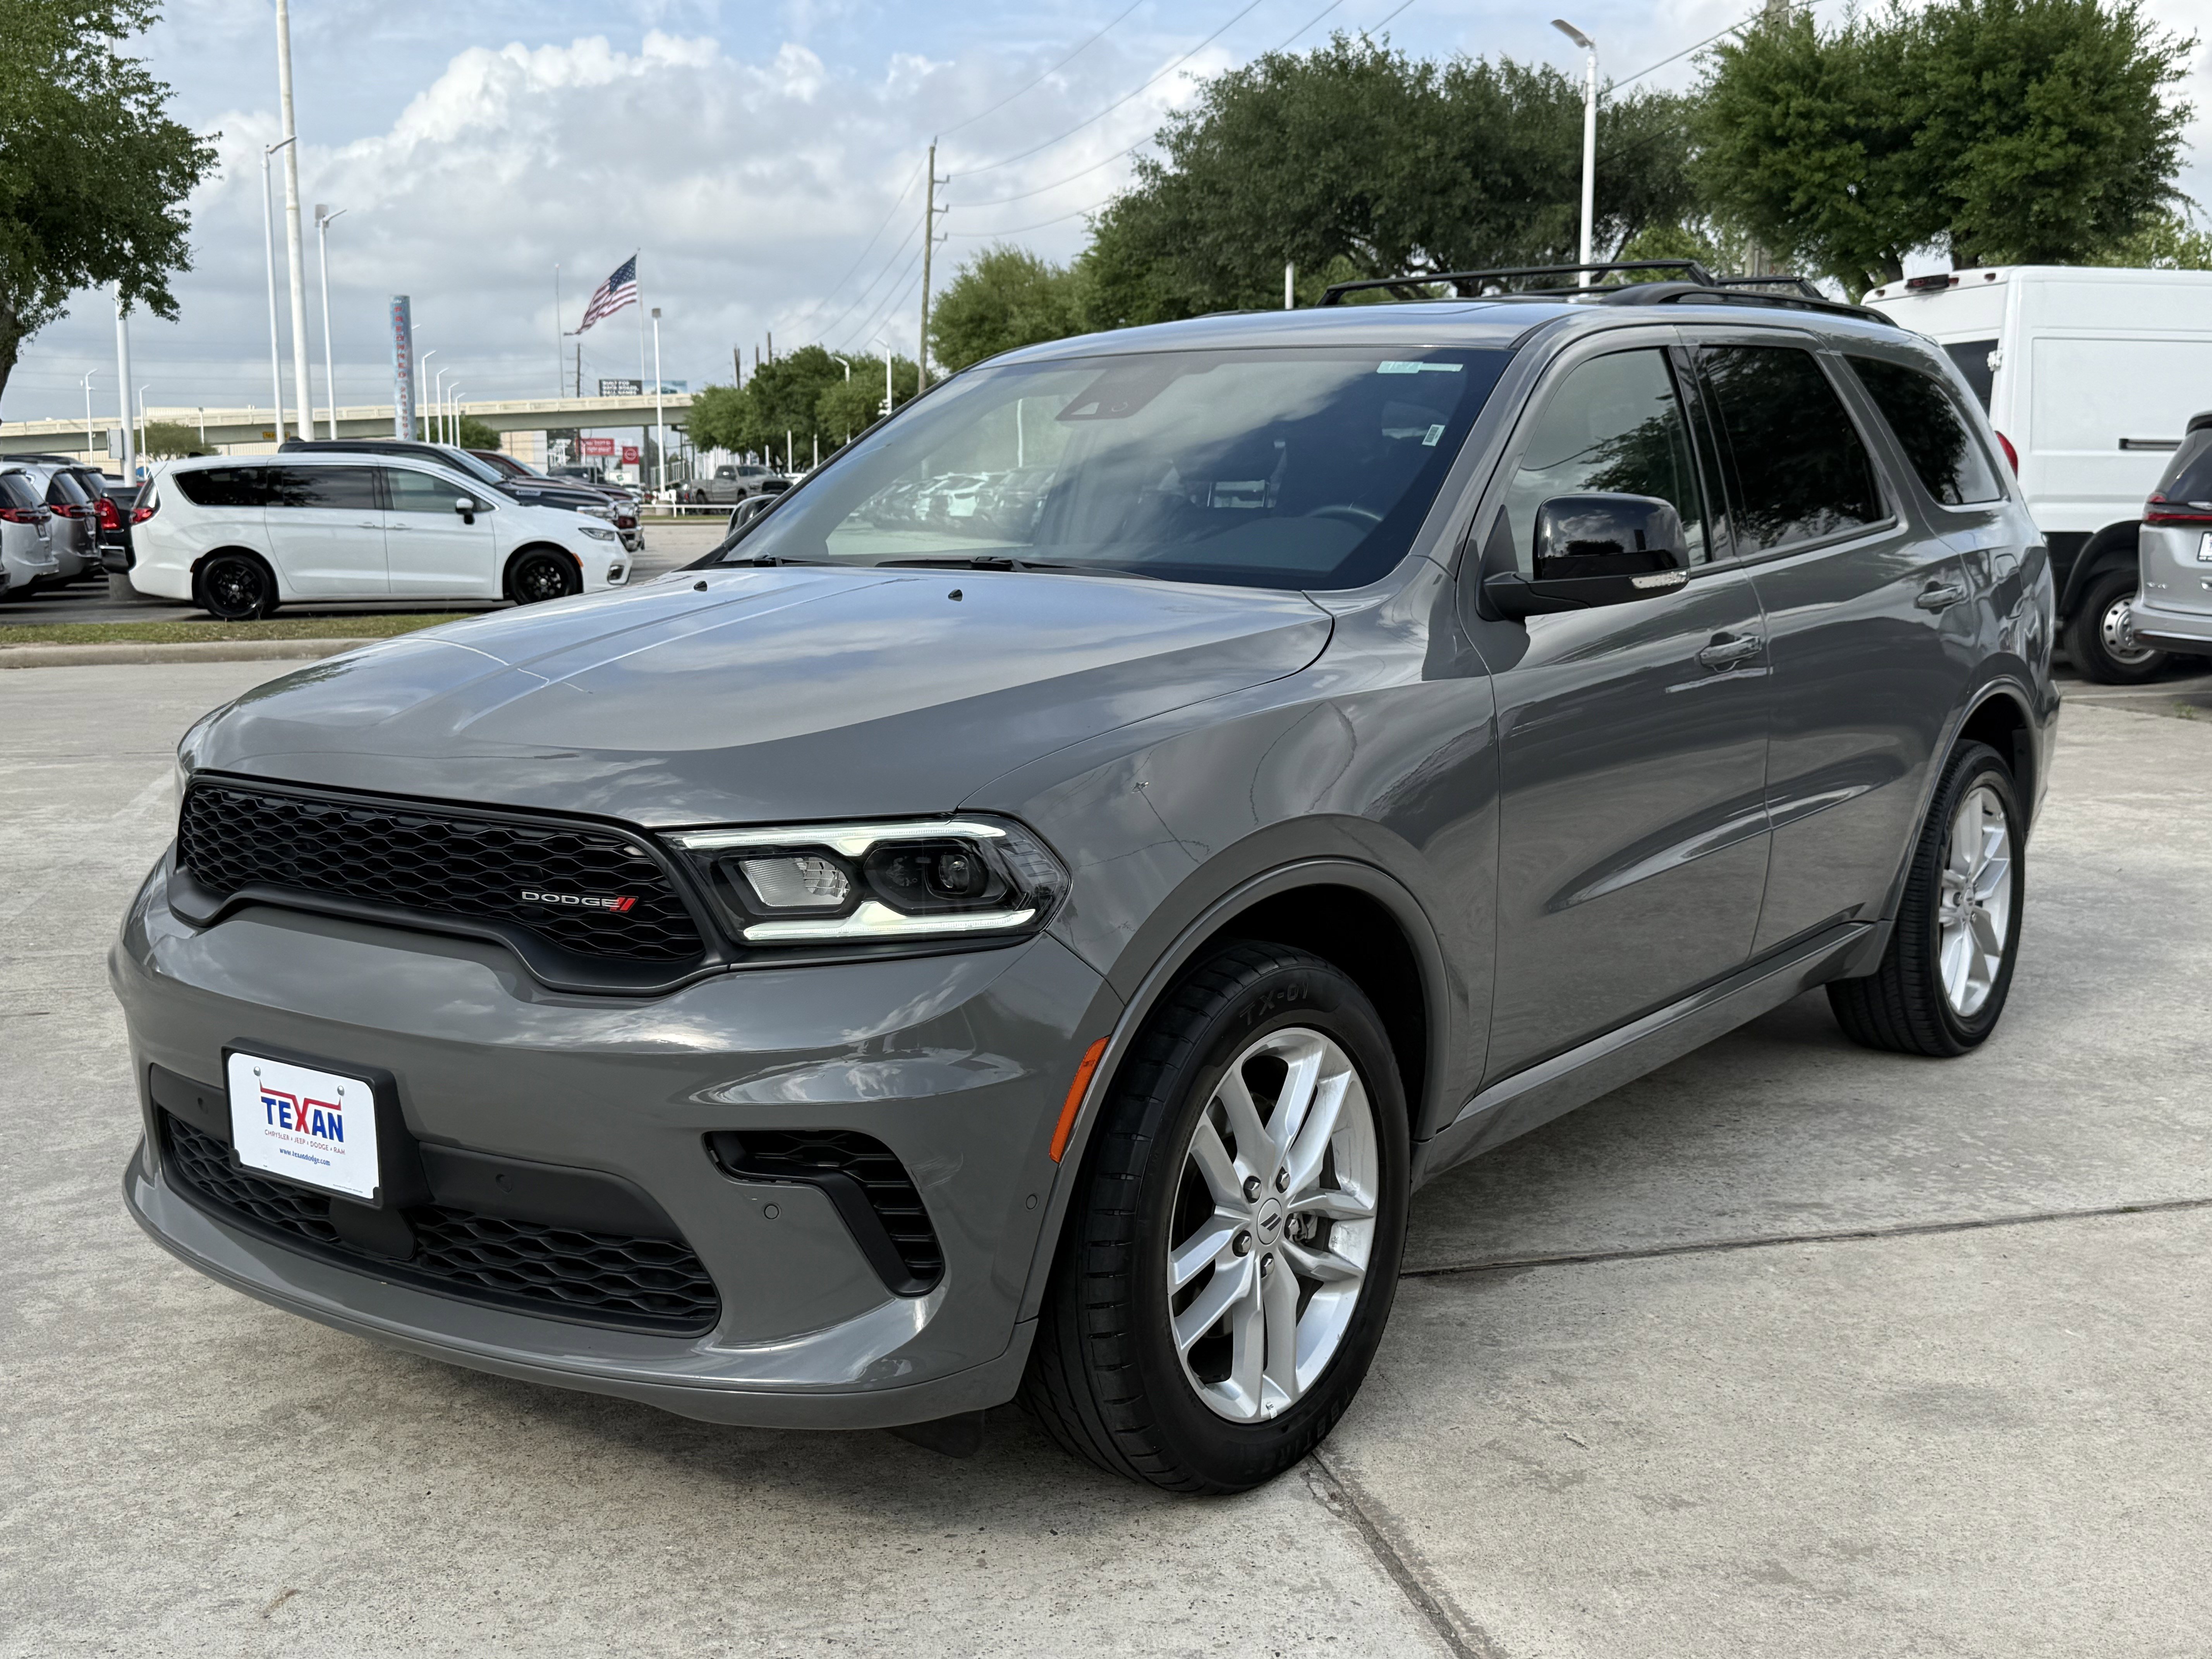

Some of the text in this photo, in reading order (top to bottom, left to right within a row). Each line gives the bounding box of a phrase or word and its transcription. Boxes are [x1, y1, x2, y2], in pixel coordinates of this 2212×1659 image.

[522, 891, 620, 908] DODGE
[1239, 979, 1309, 1025] TX-01
[261, 1094, 344, 1142] TEXAN
[265, 1129, 346, 1155] CHRYSLER JEEP DODGE RAM
